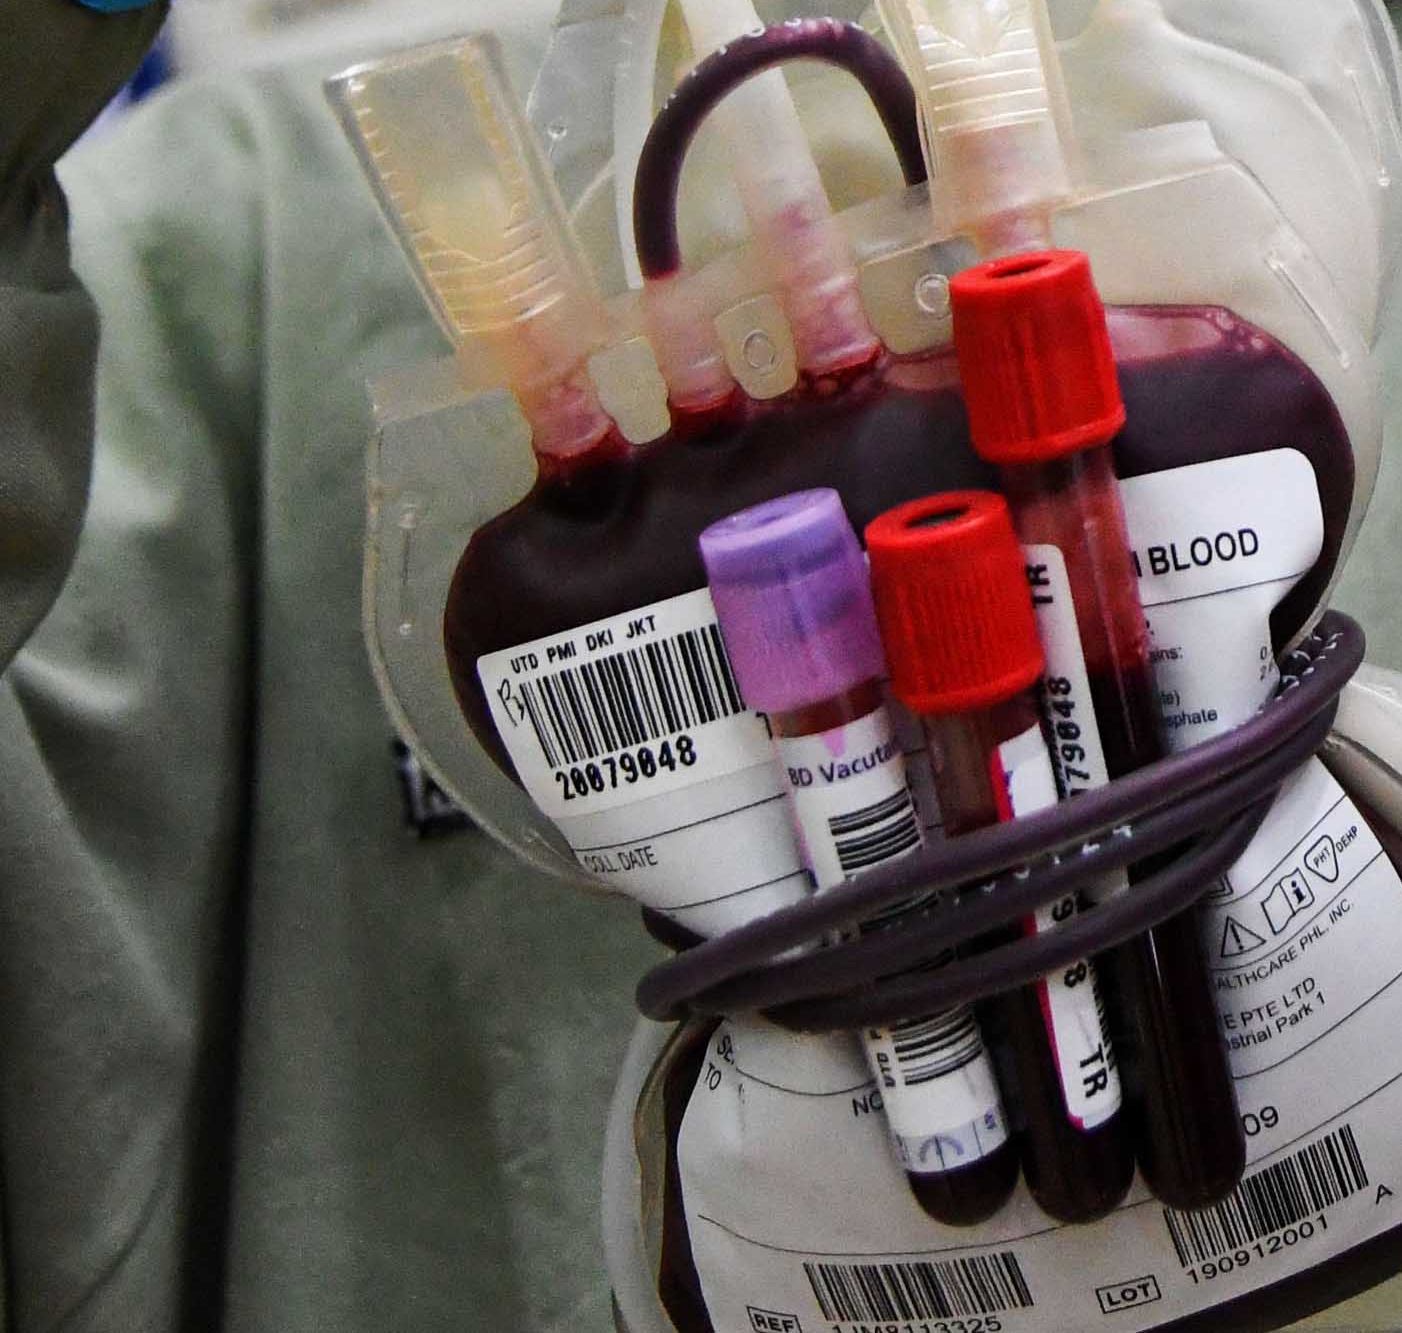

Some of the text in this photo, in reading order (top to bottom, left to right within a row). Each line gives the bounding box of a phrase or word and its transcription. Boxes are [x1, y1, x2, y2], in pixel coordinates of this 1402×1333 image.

[1148, 528, 1260, 576] BLOOD
[510, 615, 657, 674] UTD PMI DKI JKT
[555, 735, 697, 801] 20079048
[787, 767, 813, 787] BD
[620, 845, 659, 872] DATE
[1312, 825, 1358, 869] PHT DEHP
[1299, 924, 1330, 951] PHL.
[1329, 898, 1355, 924] INC.
[1240, 1000, 1280, 1027] PTE
[1282, 977, 1317, 1007] LTD
[1275, 1003, 1314, 1034] Park
[1316, 991, 1326, 1005] 1
[1079, 1042, 1109, 1099] TR
[1375, 1184, 1394, 1205] A
[1185, 1215, 1330, 1285] 190912001
[1105, 1282, 1152, 1308] LOT
[754, 1315, 795, 1333] REF
